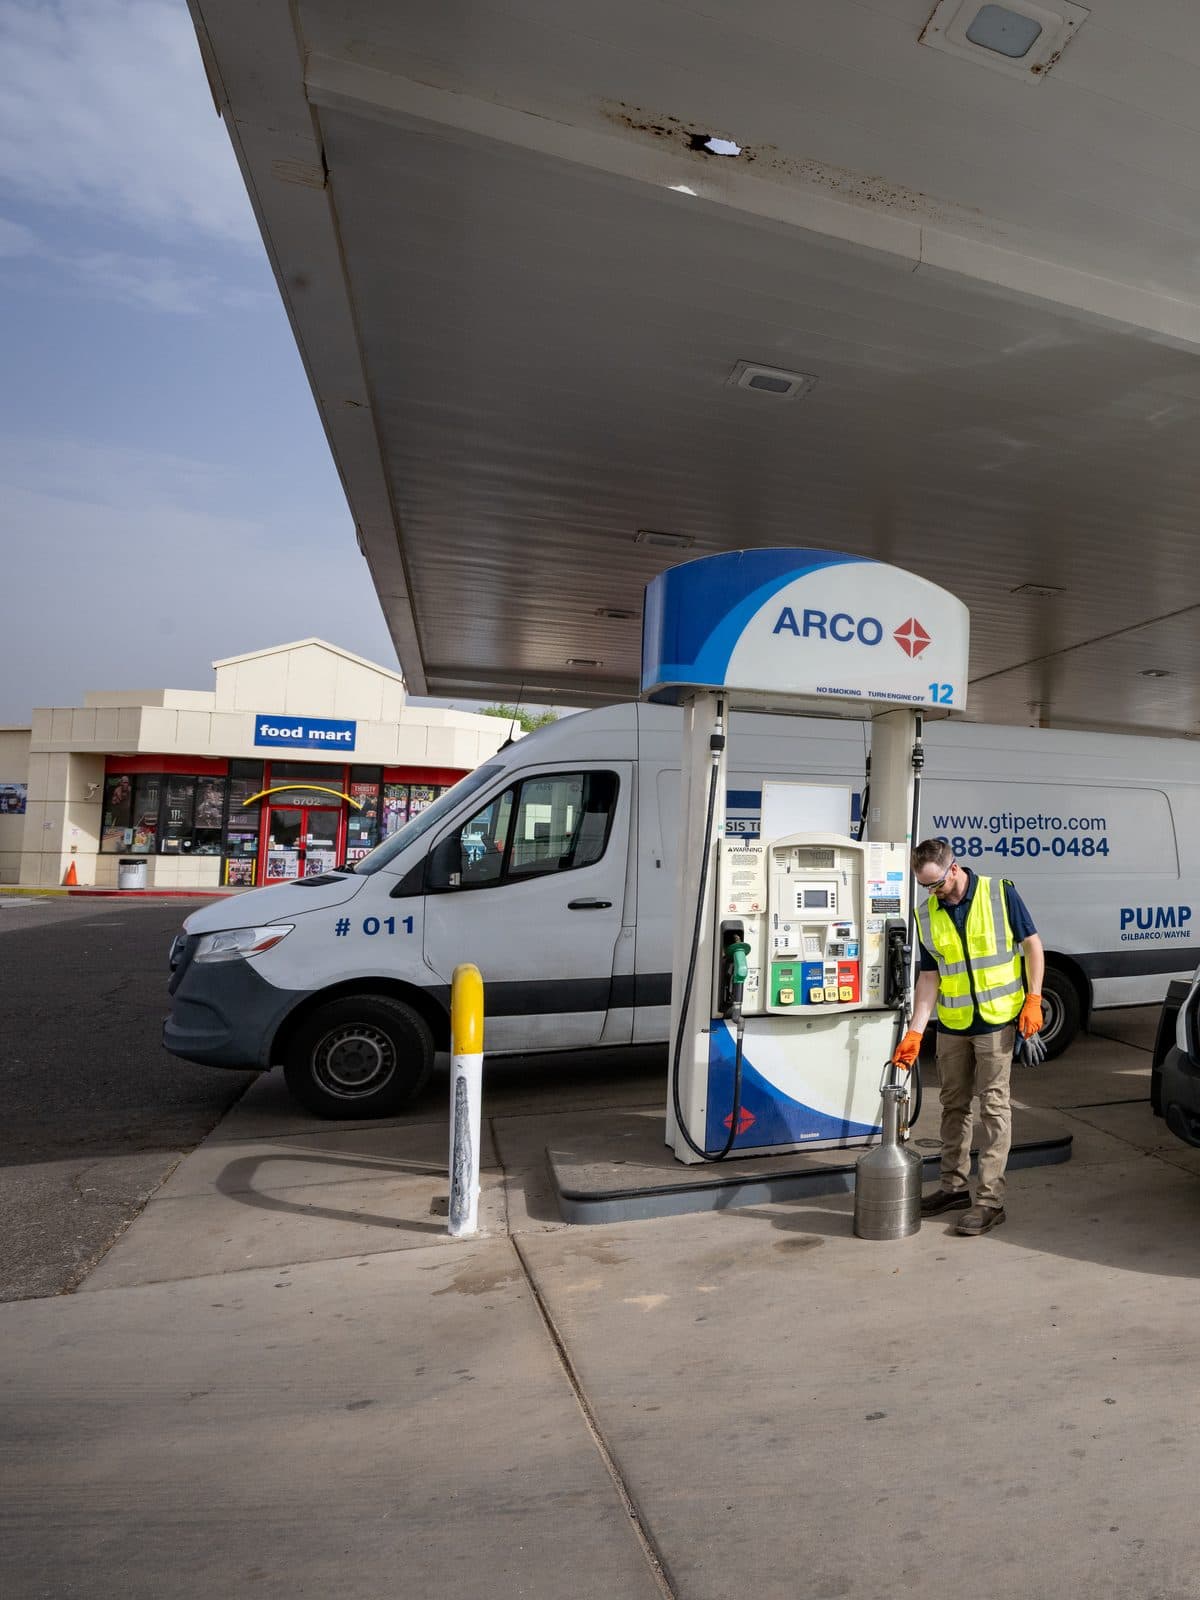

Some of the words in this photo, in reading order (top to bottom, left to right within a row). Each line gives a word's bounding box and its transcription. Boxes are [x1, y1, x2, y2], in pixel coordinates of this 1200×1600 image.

[772, 606, 884, 647] ARCO
[828, 687, 862, 697] SMOKING
[868, 691, 887, 699] TURN
[887, 692, 912, 701] ENGINE
[928, 683, 954, 705] 12
[260, 724, 303, 738] food
[308, 729, 352, 742] mart
[292, 796, 321, 806] 6702
[932, 812, 1107, 834] www.gtipetro.com
[335, 918, 351, 936] #
[363, 916, 413, 935] 011
[1120, 906, 1192, 930] PUMP
[1120, 930, 1191, 941] GILBARCO/WAYNE
